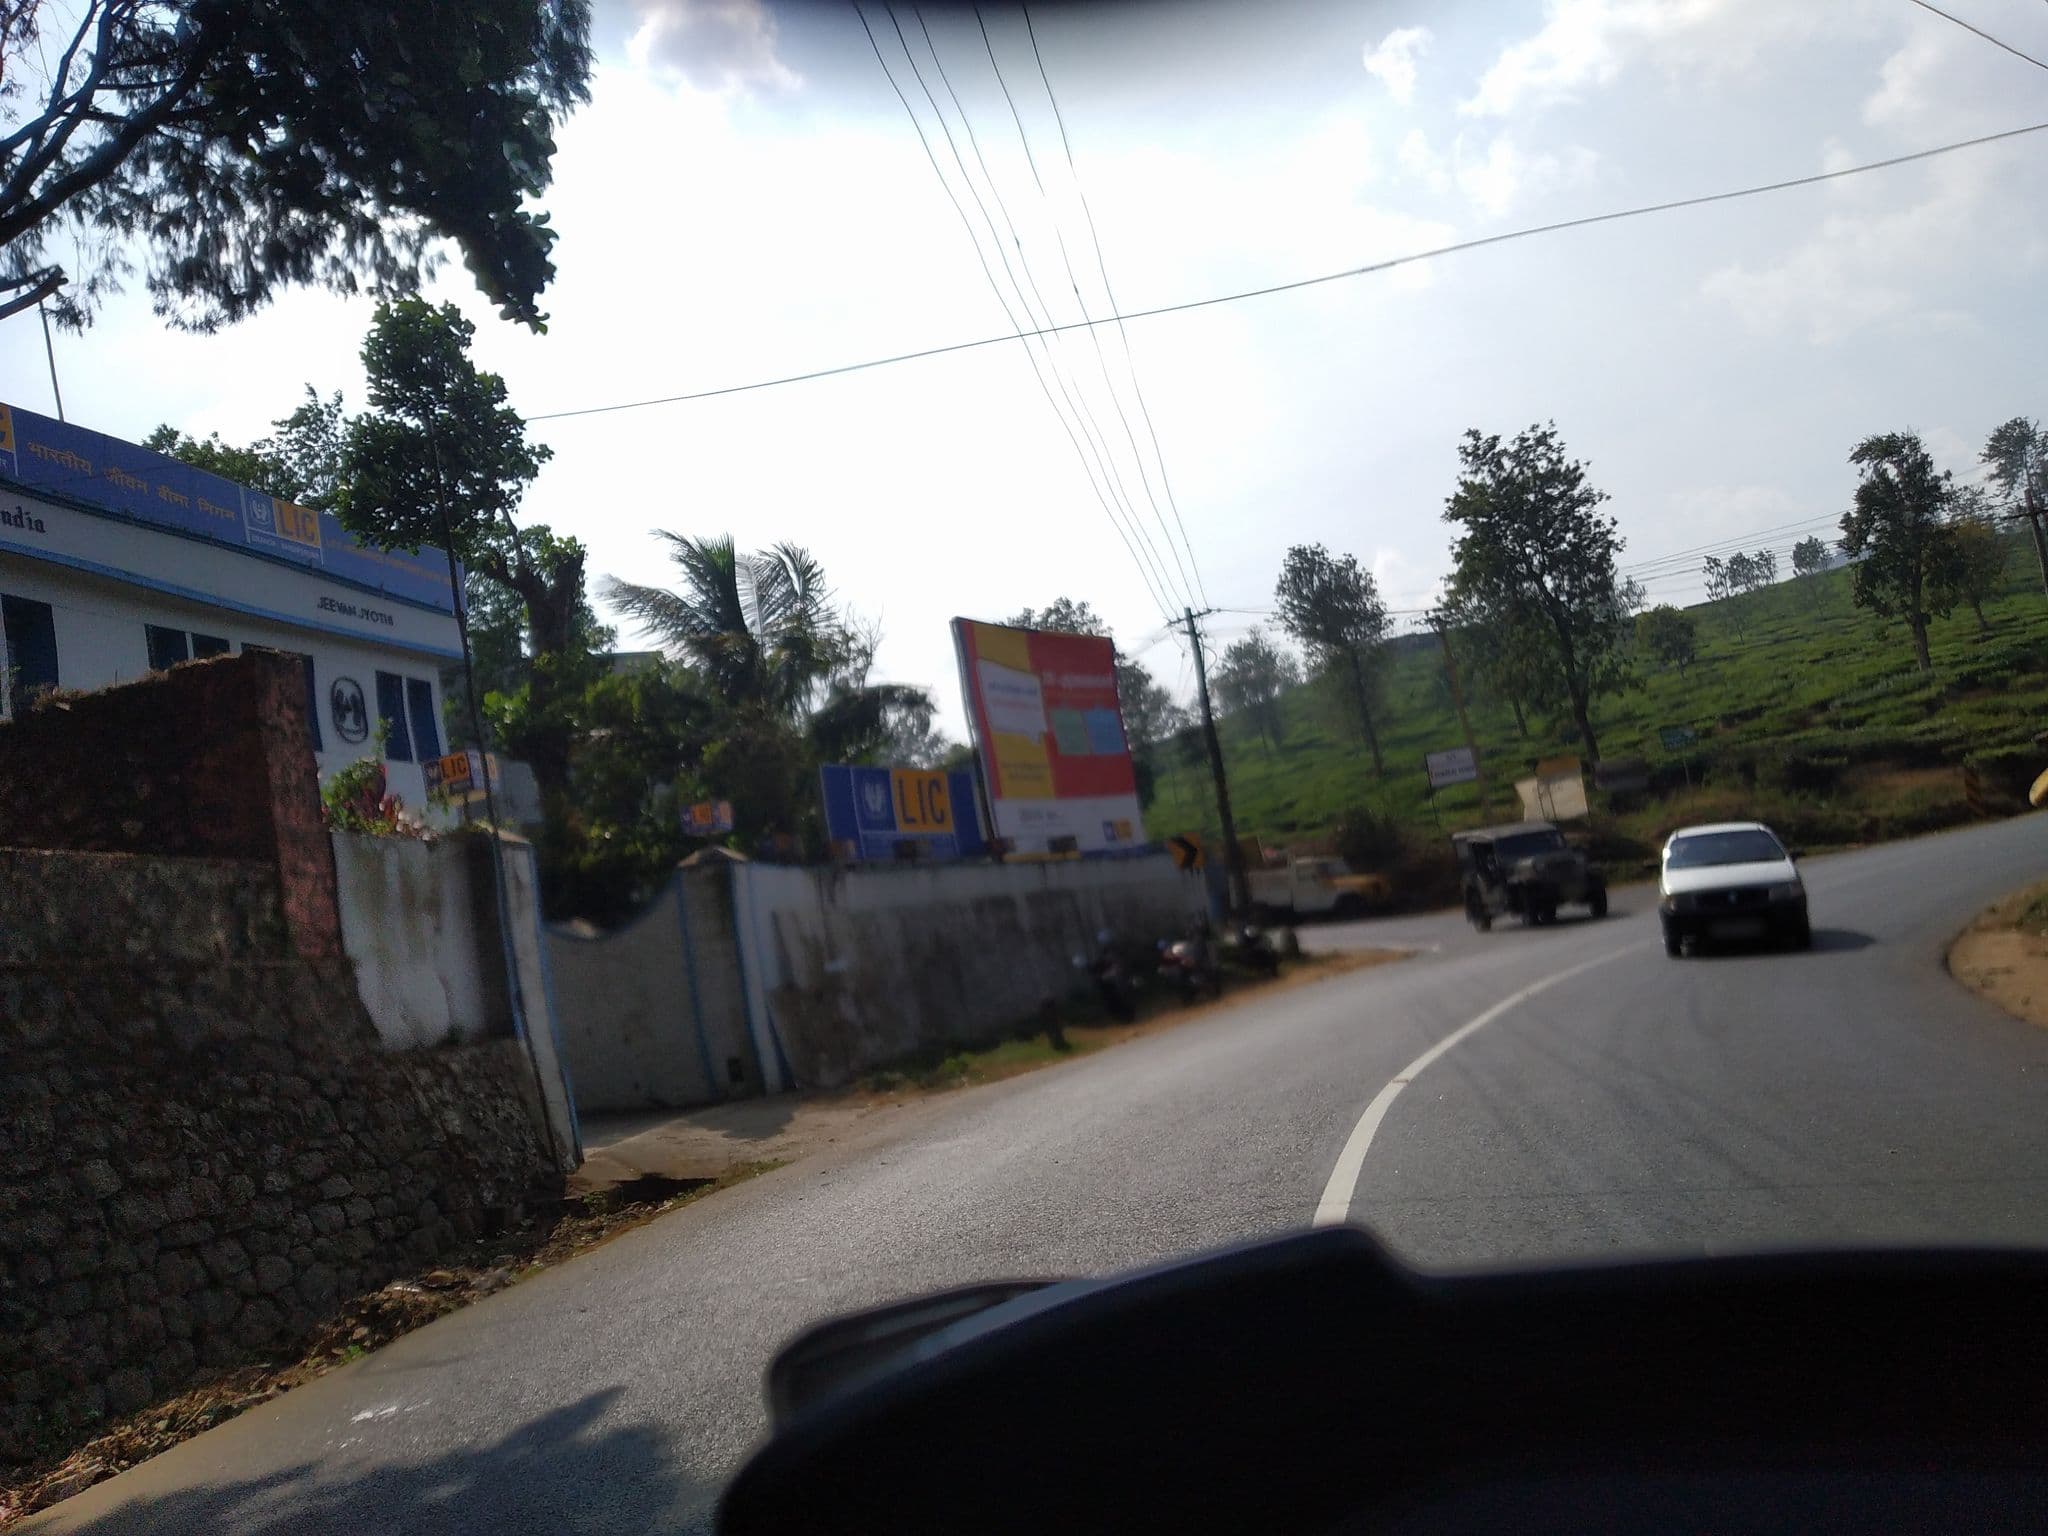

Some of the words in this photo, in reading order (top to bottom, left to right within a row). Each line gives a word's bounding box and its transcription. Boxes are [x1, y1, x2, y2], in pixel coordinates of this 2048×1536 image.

[277, 502, 317, 543] LIC
[317, 597, 358, 617] JEEVAN
[440, 755, 467, 779] LIC
[899, 778, 945, 825] LIC
